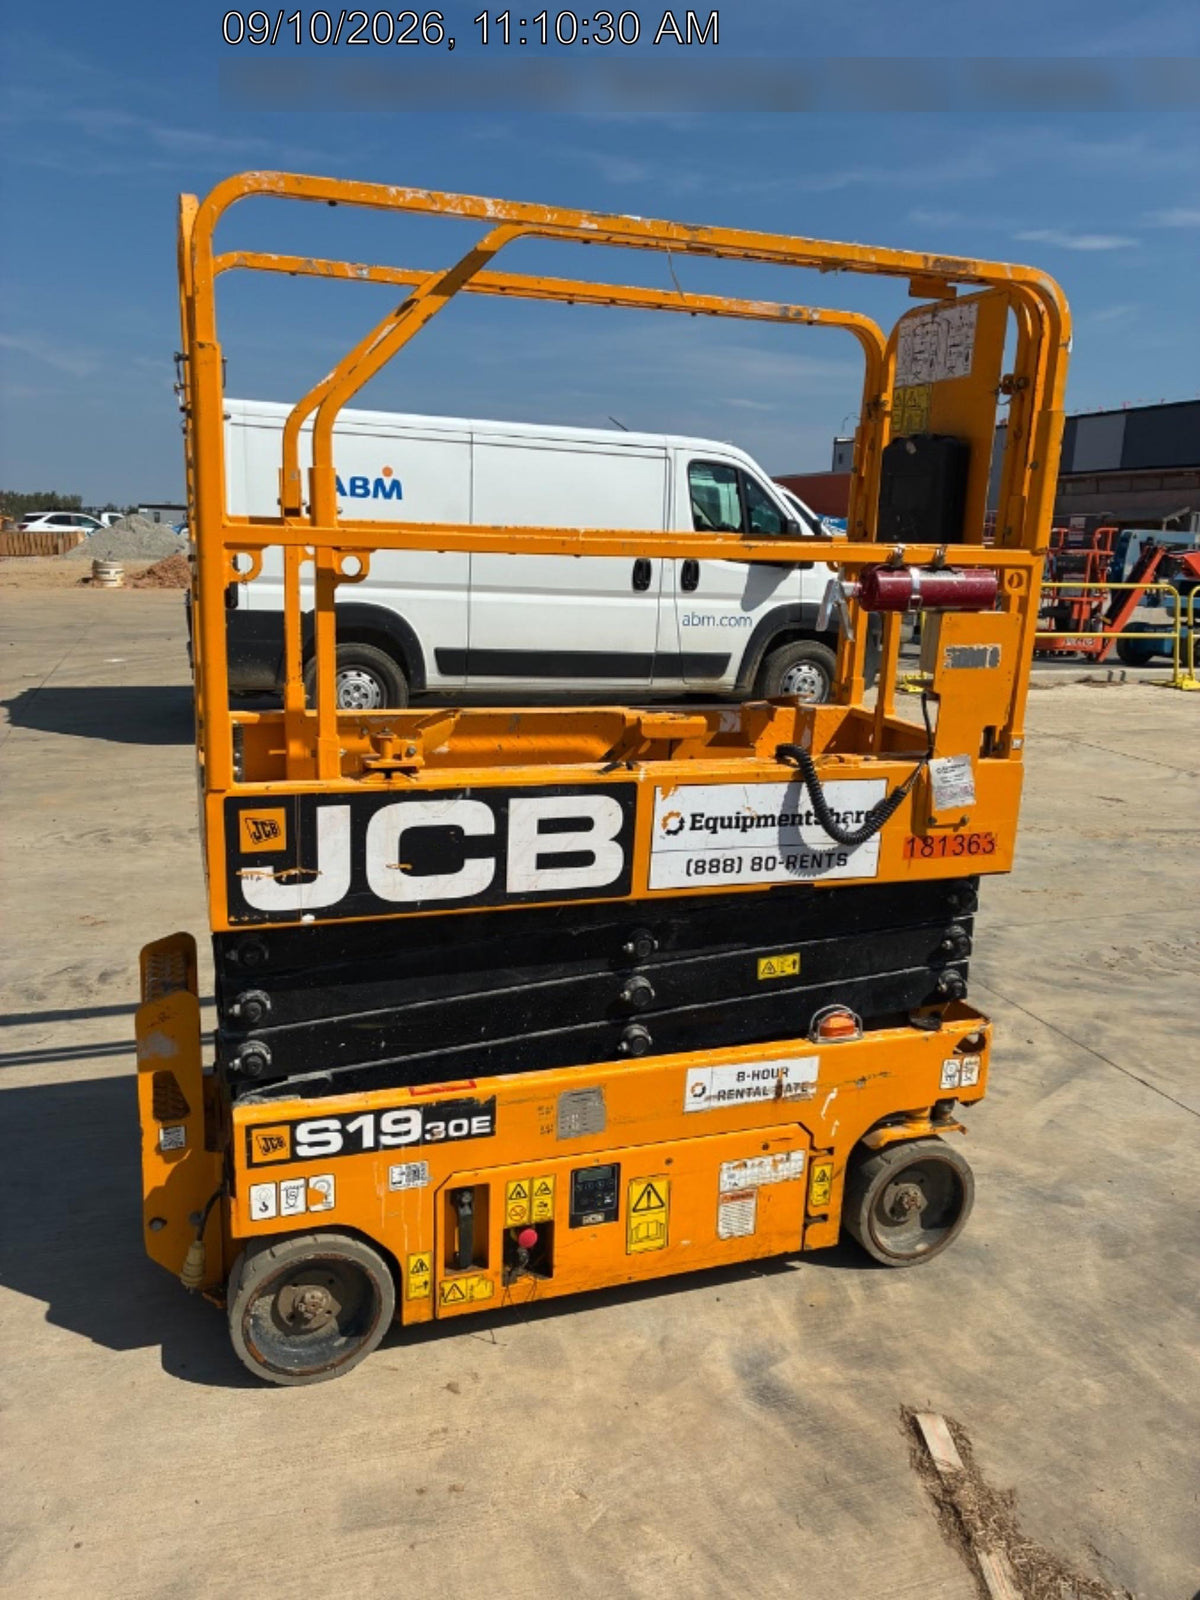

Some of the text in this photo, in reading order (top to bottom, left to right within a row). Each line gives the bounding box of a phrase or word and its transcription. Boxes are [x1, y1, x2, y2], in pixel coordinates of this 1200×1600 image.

[682, 611, 753, 627] abm.com
[250, 819, 280, 841] JCB
[241, 794, 624, 911] JCB
[907, 832, 996, 858] 181363
[686, 852, 848, 877] (888) 80-RENTS
[736, 1067, 790, 1083] 8-HOUR
[717, 1082, 808, 1101] RENTAL ATE
